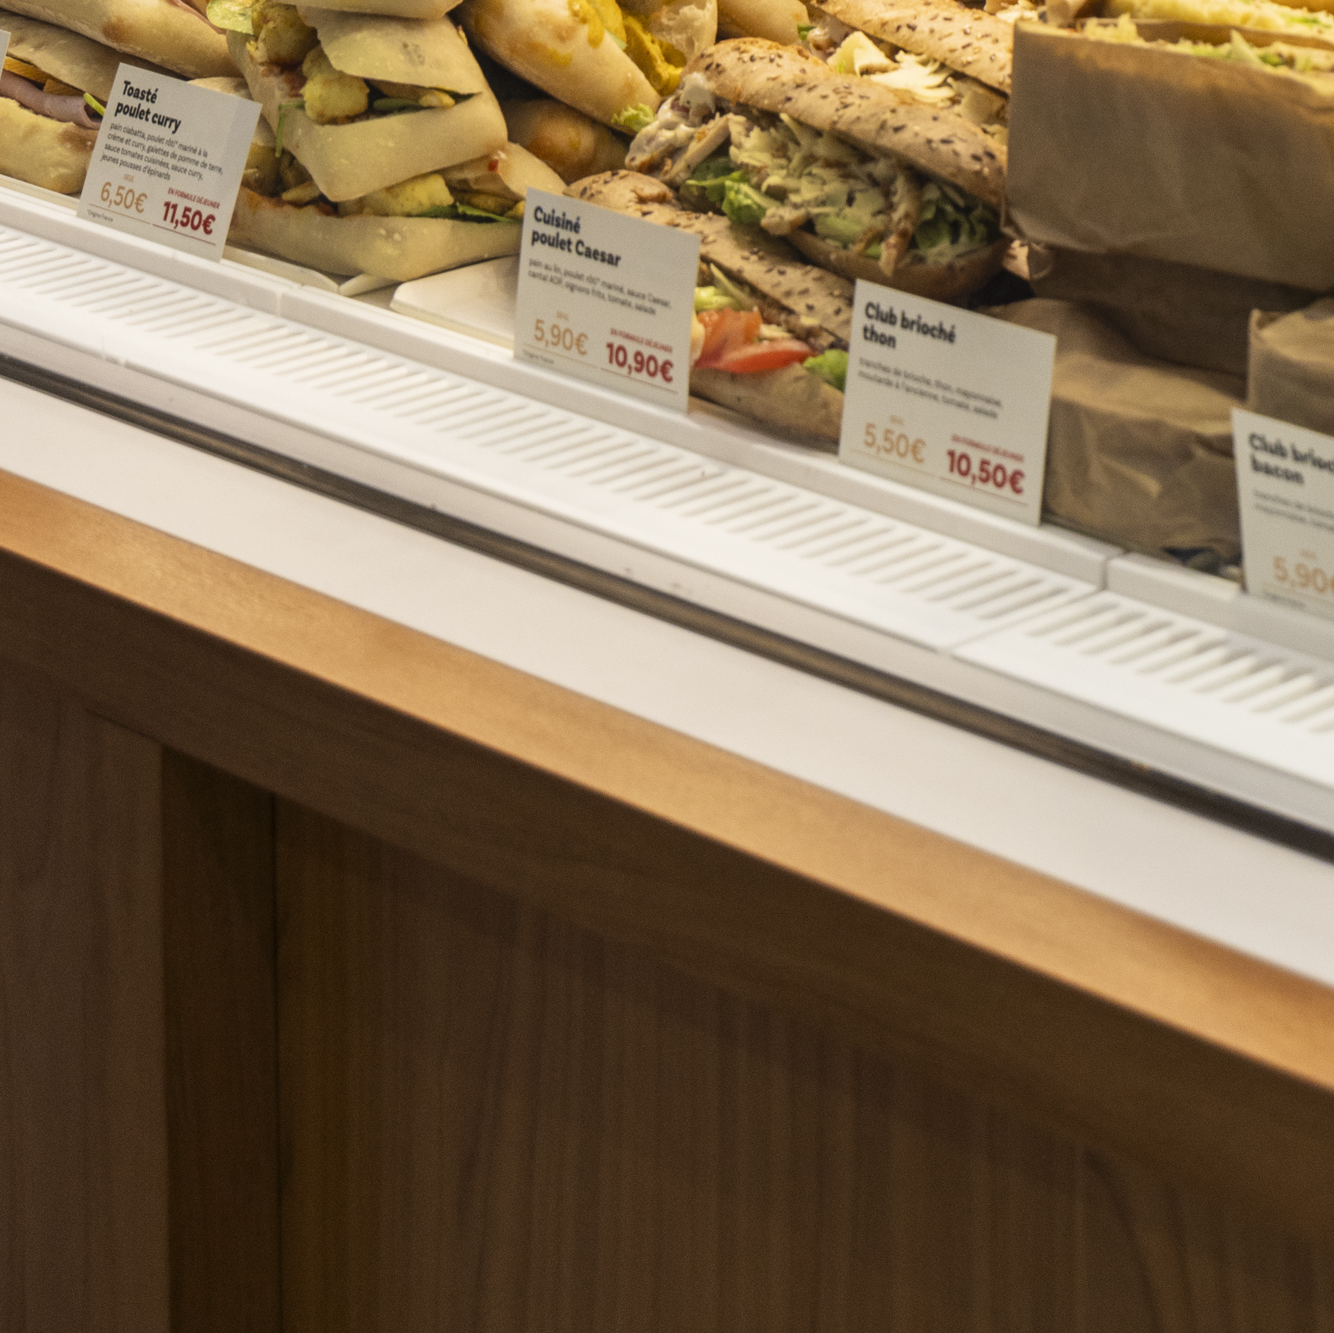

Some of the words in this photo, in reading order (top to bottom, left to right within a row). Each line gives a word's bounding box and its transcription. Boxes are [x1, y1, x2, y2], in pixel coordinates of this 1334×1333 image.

[121, 79, 158, 104] Toasté
[114, 101, 151, 122] poulet
[150, 112, 181, 135] curry
[107, 132, 124, 143] crème
[124, 137, 131, 145] et
[169, 150, 178, 159] de
[177, 154, 199, 167] pomme
[199, 160, 208, 169] de
[207, 163, 223, 175] terre,
[109, 121, 123, 131] pain
[122, 125, 146, 140] ciabatta,
[146, 133, 165, 145] poulet
[201, 149, 208, 157] la
[100, 153, 119, 165] jeunes
[118, 159, 141, 172] pousses
[104, 143, 120, 153] sauce
[120, 147, 143, 161] tomates
[170, 164, 187, 174] sauce
[99, 180, 148, 214] 6,50€
[162, 200, 216, 235] 11,50€
[533, 205, 580, 234] Cuisiné
[530, 229, 572, 253] poulet
[574, 238, 621, 267] Caesar
[533, 318, 588, 356] 5,90€
[862, 324, 897, 348] thon
[864, 301, 898, 326] Club
[900, 311, 956, 343] brioché
[605, 341, 673, 383] 10,90€
[863, 422, 926, 464] 5,50€
[946, 449, 1024, 494] 10,50€
[1247, 432, 1288, 459] Club
[1250, 454, 1304, 484] bacon
